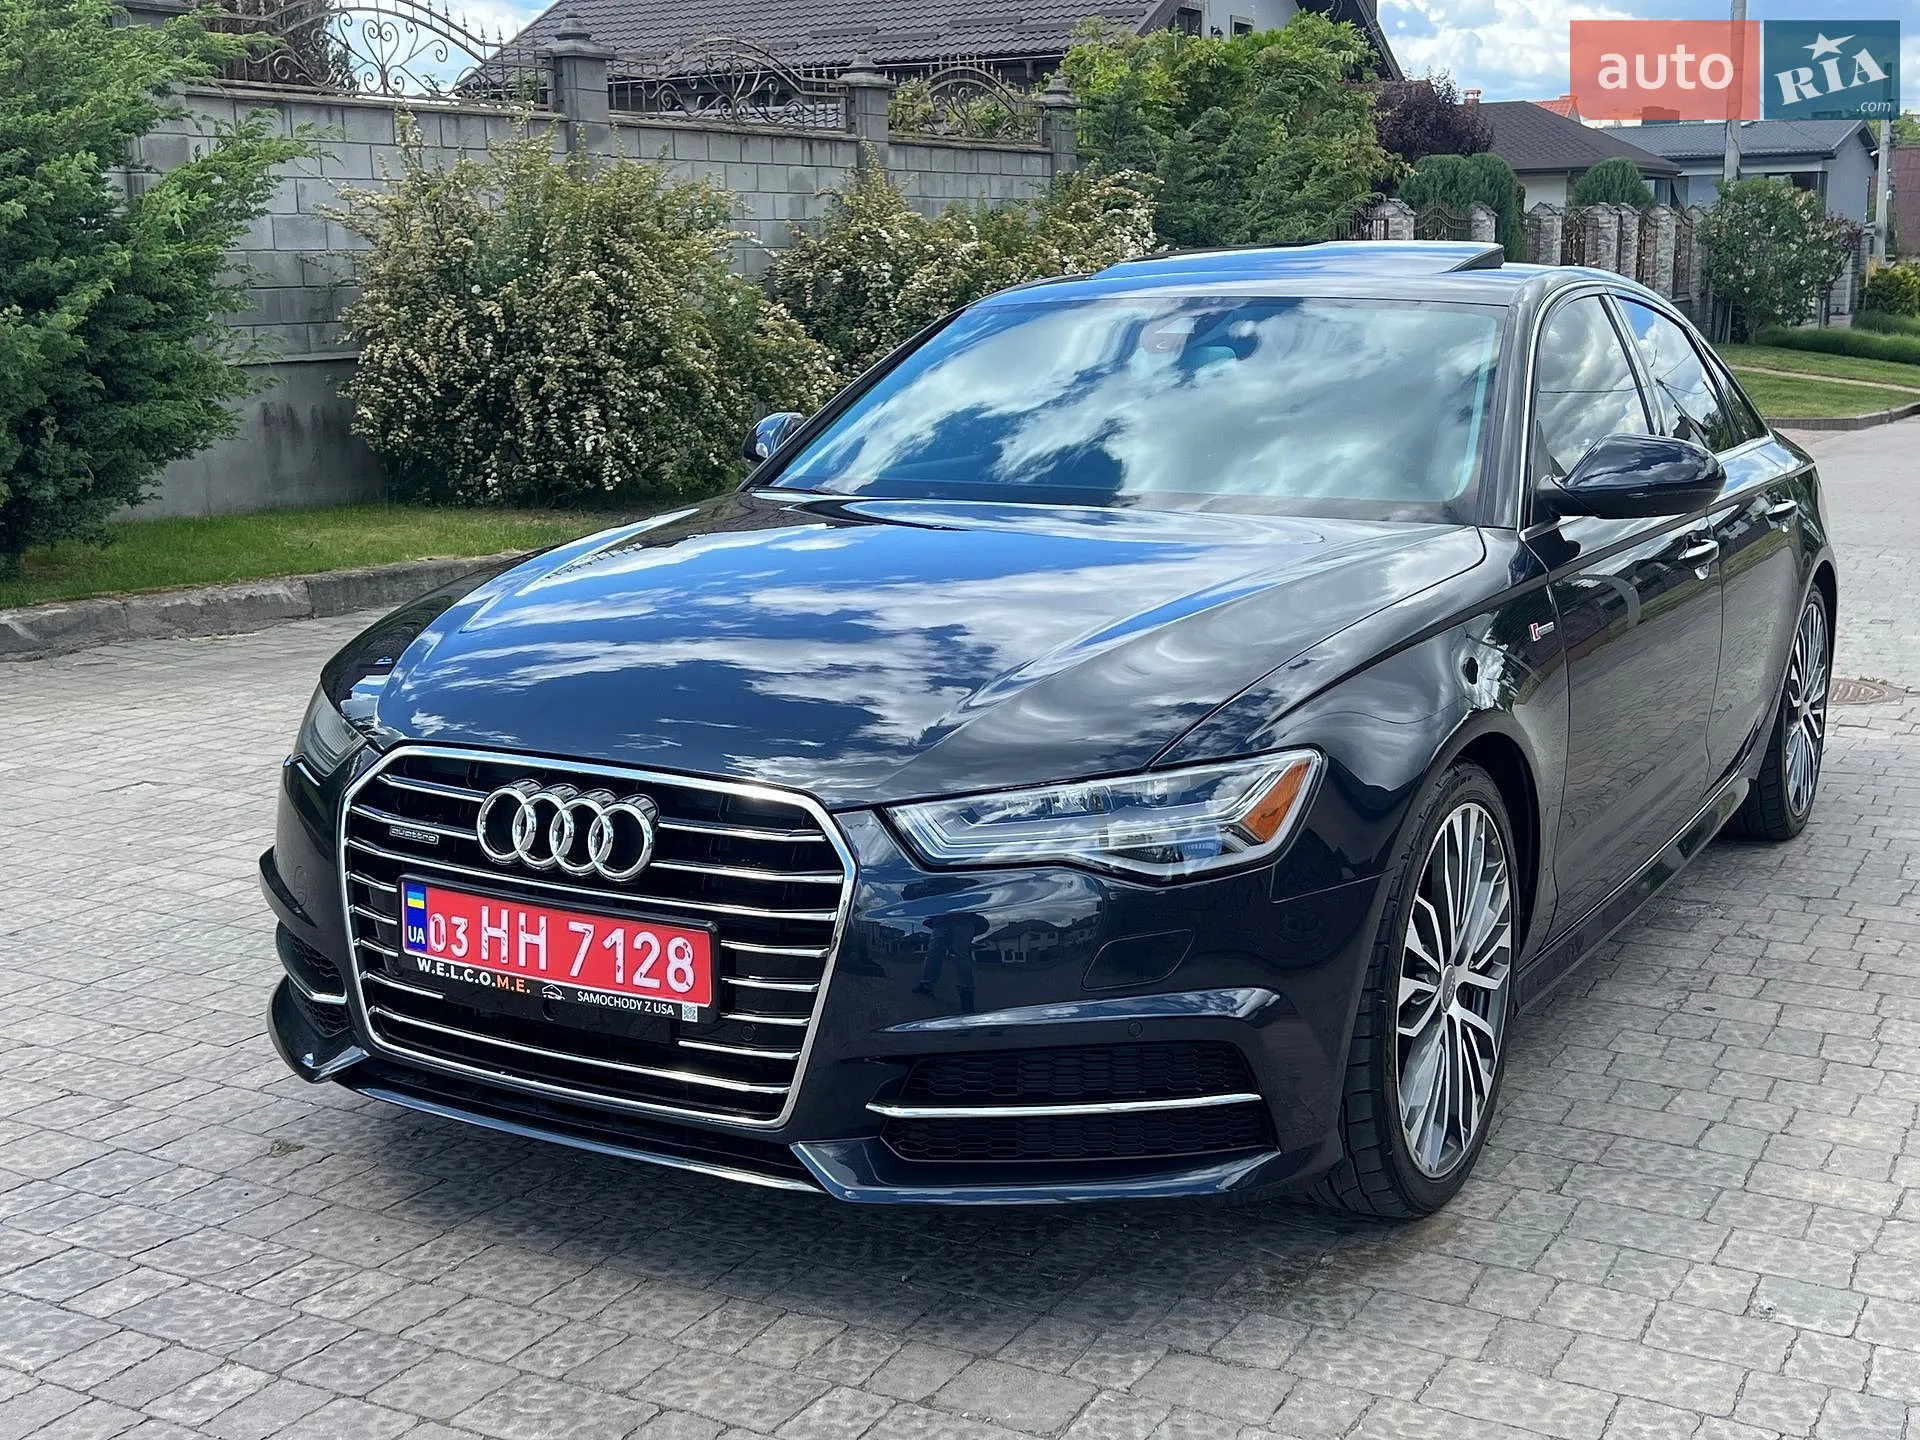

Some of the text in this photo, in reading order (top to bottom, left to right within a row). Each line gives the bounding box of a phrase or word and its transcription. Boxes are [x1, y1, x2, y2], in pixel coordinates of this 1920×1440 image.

[391, 828, 436, 841] quattro
[408, 925, 426, 944] UA
[429, 905, 695, 993] 03 HH 7128
[416, 957, 531, 994] W.E.L.C.O.M.E.
[577, 991, 675, 1016] SAMOCHODY Z USA
